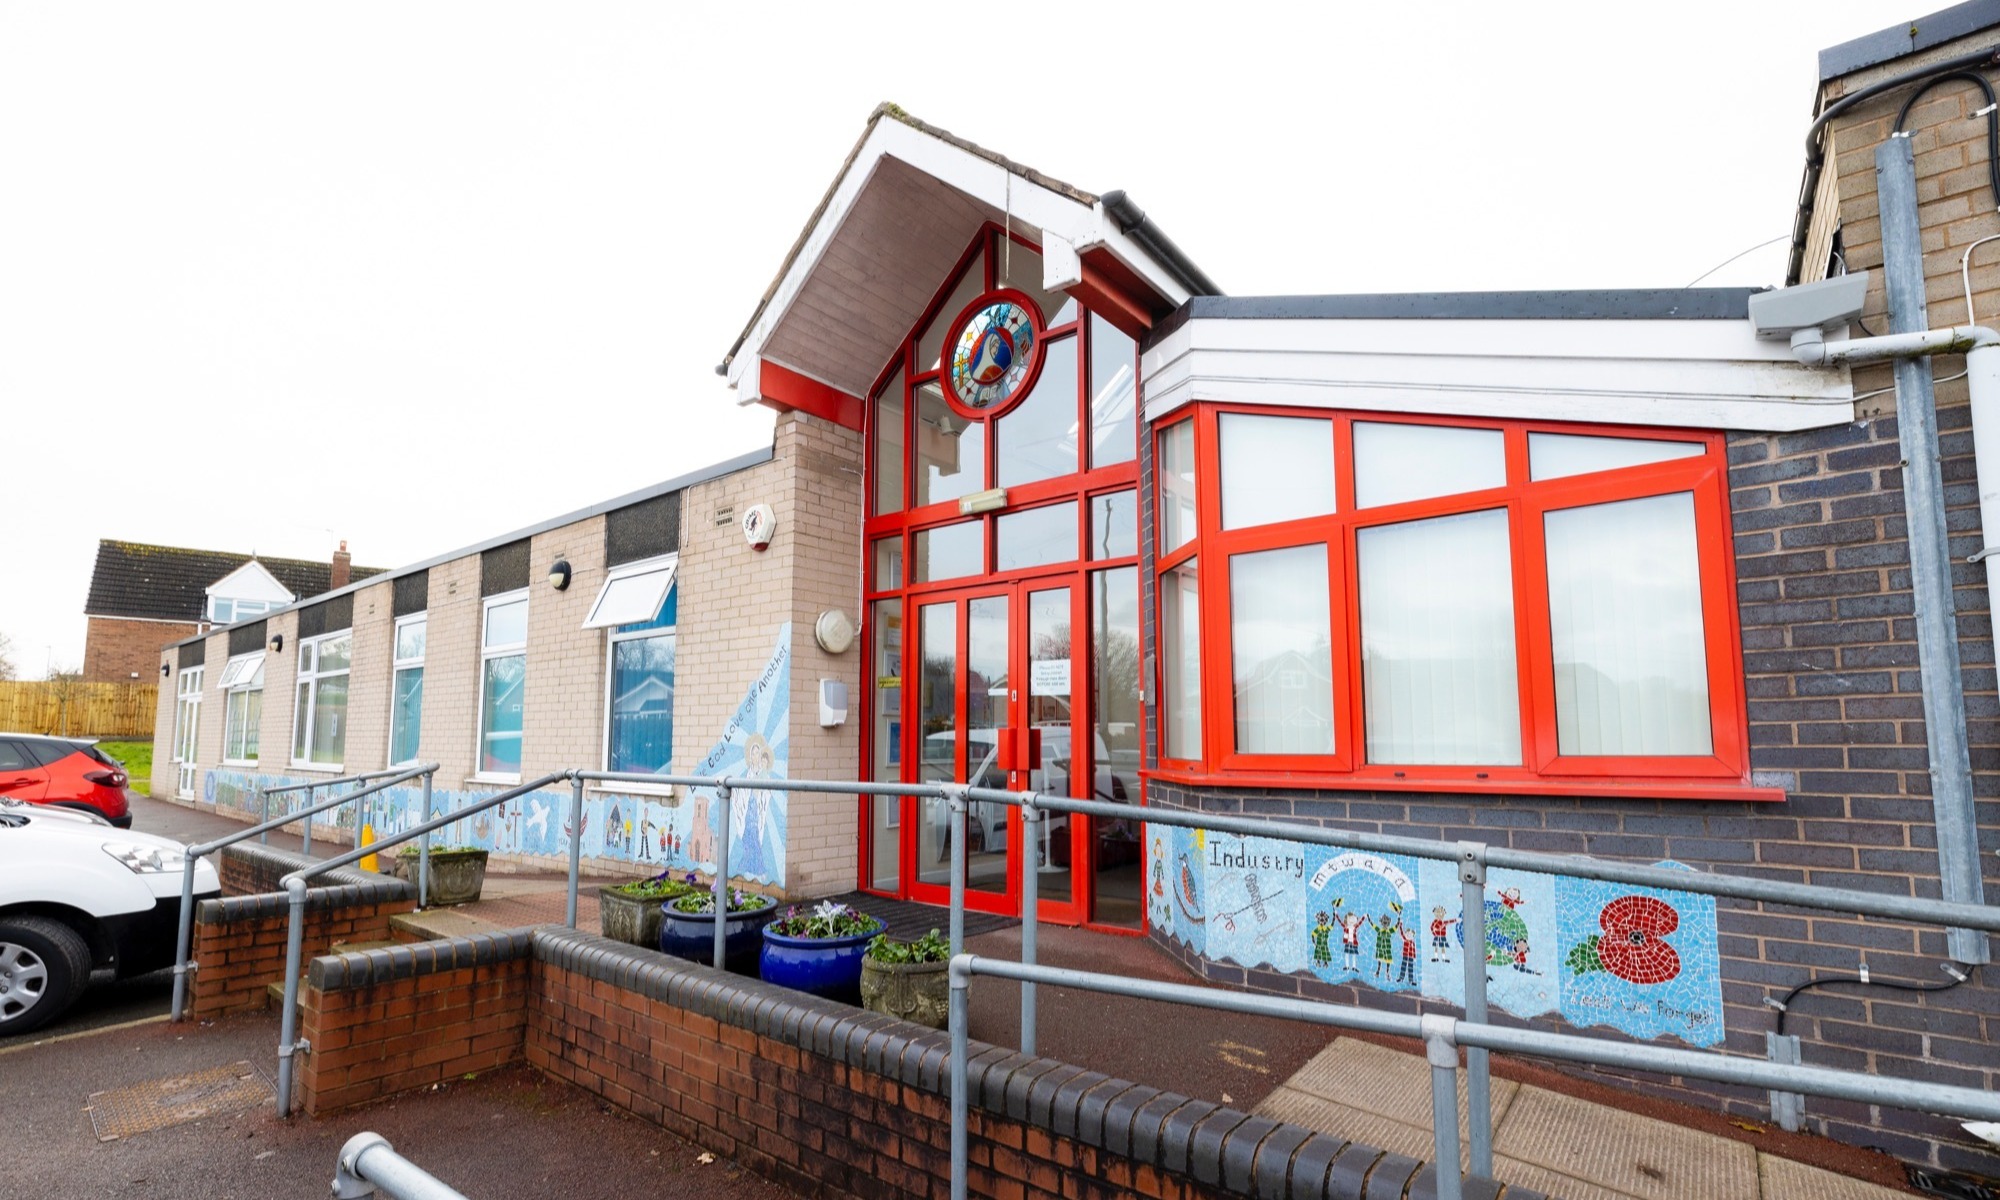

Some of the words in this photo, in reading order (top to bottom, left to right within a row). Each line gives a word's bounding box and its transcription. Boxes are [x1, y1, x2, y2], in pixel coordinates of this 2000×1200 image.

[707, 745, 726, 768] God
[724, 712, 743, 743] Love
[745, 690, 758, 714] one
[758, 644, 788, 694] Another
[1209, 840, 1304, 878] Industry
[1620, 999, 1650, 1016] We
[1657, 1000, 1715, 1029] Forget
